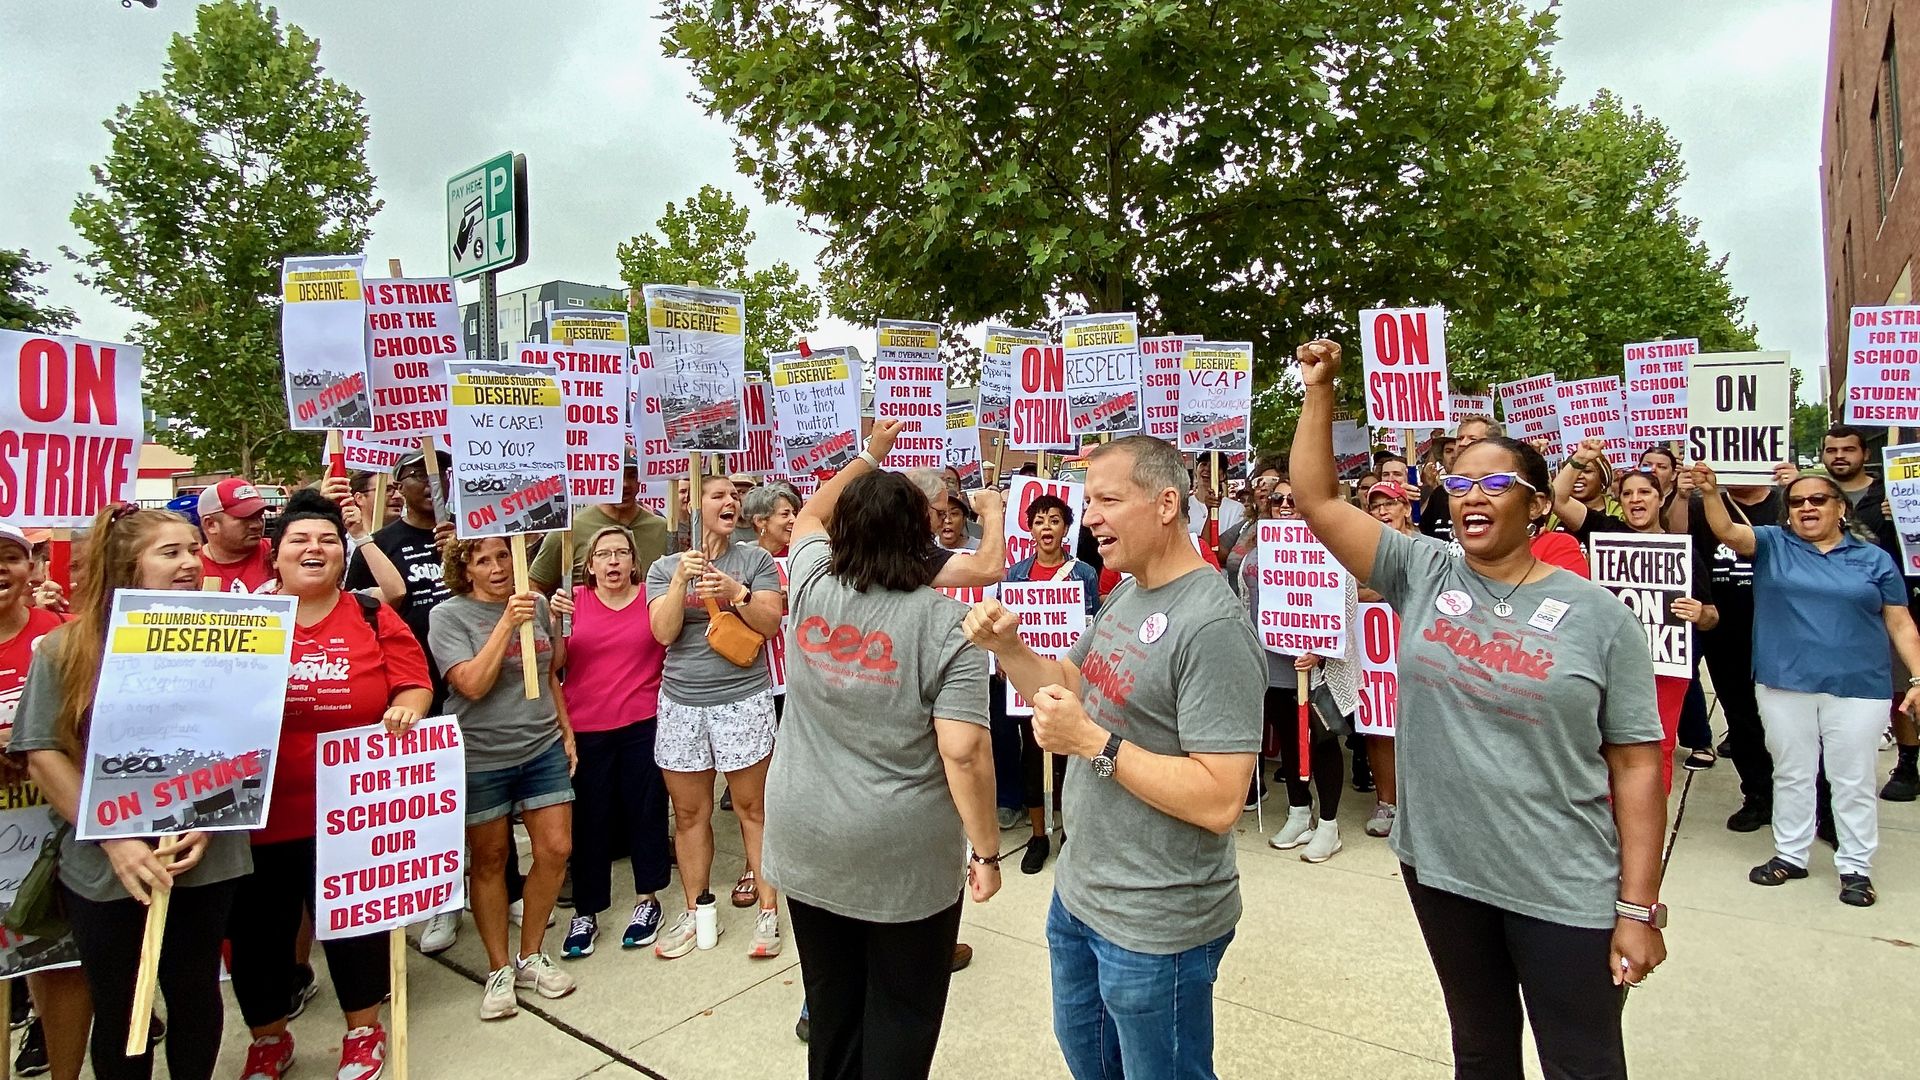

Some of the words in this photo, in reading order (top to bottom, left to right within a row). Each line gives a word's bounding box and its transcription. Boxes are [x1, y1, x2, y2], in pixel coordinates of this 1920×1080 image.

[452, 187, 464, 200] PAY
[466, 178, 483, 195] HERE
[490, 167, 507, 212] P
[325, 270, 350, 281] STUDENTS
[299, 281, 349, 302] DESERVE:
[364, 285, 375, 305] N
[380, 284, 453, 305] STRIKE
[370, 313, 403, 330] FOR
[406, 312, 436, 328] THE
[591, 320, 617, 328] STUDENTS
[666, 311, 725, 333] DESERVE:
[1074, 325, 1100, 333] COLUMBUS
[1101, 323, 1125, 331] STUDENTS
[1853, 312, 1877, 327] ON
[566, 328, 614, 341] DESERVE:
[655, 331, 708, 355] Talisa
[1077, 332, 1122, 346] DESERVE:
[1374, 313, 1429, 366] ON
[1869, 332, 1896, 344] FOR
[374, 335, 457, 357] CHOOLS
[1143, 342, 1160, 354] ON
[1162, 340, 1182, 353] STR
[1627, 348, 1644, 361] ON
[1647, 343, 1695, 359] STRIKE
[394, 362, 429, 379] OUR
[553, 352, 621, 375] STRIKE
[783, 361, 811, 370] COLUMBUS
[811, 358, 837, 368] STUDENTS
[1022, 347, 1063, 393] ON
[1067, 353, 1137, 385] RESPECT
[1155, 358, 1174, 369] FOR
[1195, 358, 1238, 370] DESERVE:
[1640, 364, 1661, 374] FOR
[1663, 361, 1683, 373] THE
[19, 339, 117, 426] ON
[294, 374, 321, 387] cea
[468, 375, 509, 386] COLUMBUS
[511, 376, 546, 387] STUDENTS
[787, 366, 837, 385] DESERVE:
[879, 366, 896, 380] ON
[899, 366, 943, 381] STRIKE
[1147, 374, 1179, 386] SCHO
[1189, 370, 1246, 389] VCAP
[1880, 369, 1910, 381] OUR
[298, 398, 318, 421] ON
[319, 372, 365, 411] STRIKE
[373, 384, 448, 407] TUDENT
[474, 387, 544, 405] DESERVE:
[575, 380, 603, 397] THE
[795, 388, 807, 401] be
[811, 382, 845, 400] treated
[890, 386, 911, 397] FOR
[913, 386, 932, 398] THE
[1166, 390, 1179, 400] OU
[1208, 387, 1227, 396] NOT
[1370, 371, 1445, 422] STRIKE
[1501, 384, 1515, 398] ON
[1516, 377, 1553, 396] STRIKE
[1557, 386, 1574, 398] ON
[1576, 380, 1618, 395] STRIKE
[1716, 375, 1757, 412] ON
[1850, 387, 1920, 400] STUDENT
[794, 403, 809, 415] like
[813, 400, 835, 413] they
[1072, 396, 1097, 406] cea
[1454, 400, 1470, 409] FOR
[1471, 401, 1484, 410] THE
[1513, 398, 1528, 408] FOR
[1529, 394, 1545, 405] THE
[1570, 400, 1589, 410] FOR
[1590, 397, 1608, 408] THE
[1652, 393, 1675, 404] OUR
[880, 403, 942, 417] SCHOOLS
[982, 411, 995, 423] ON
[1074, 414, 1090, 429] ON
[1094, 392, 1135, 420] STRIKE
[1184, 415, 1208, 423] cea
[1507, 404, 1556, 424] SCHOOLS
[1563, 409, 1619, 427] SCHOOLS
[1631, 407, 1688, 421] STUDENT
[374, 409, 448, 432] DESERV
[471, 413, 494, 428] WE
[500, 415, 543, 430] CARE!
[797, 413, 840, 431] matter!
[1525, 421, 1543, 432] OUR
[1184, 431, 1200, 445] ON
[1203, 415, 1245, 439] STRIKE
[1584, 426, 1604, 437] OUR
[468, 440, 492, 456] DO
[498, 440, 535, 458] YOU?
[787, 437, 813, 447] cea
[791, 455, 809, 472] ON
[810, 429, 855, 463] STRIKE
[1689, 426, 1784, 462] STRIKE
[345, 447, 400, 468] ESERV
[0, 430, 133, 517] STRIKE
[459, 463, 516, 472] COUNSELORS
[531, 462, 566, 470] STUDENTS
[465, 479, 507, 493] cea
[468, 505, 497, 530] ON
[501, 475, 563, 516] STRIKE
[1261, 526, 1282, 543] ON
[1274, 550, 1298, 564] FOR
[1301, 550, 1325, 565] THE
[1596, 549, 1686, 585] TEACHERS
[1263, 569, 1339, 588] SCHOOLS
[1005, 589, 1025, 605] ON
[1027, 587, 1081, 605] STRIKE
[1287, 592, 1312, 607] OUR
[1441, 593, 1461, 613] cea
[143, 613, 206, 626] COLUMBUS
[209, 614, 268, 627] STUDENTS
[1020, 612, 1041, 625] FOR
[1044, 611, 1067, 625] THE
[1261, 611, 1341, 630] STUDENTS
[146, 628, 257, 653] DESERVE:
[797, 615, 898, 672] cea
[1020, 631, 1080, 648] CHOOLS
[1266, 632, 1338, 650] DESERVE!
[322, 738, 360, 767] ON
[368, 724, 459, 760] STRIKE
[102, 755, 167, 774] cea
[350, 768, 390, 796] FOR
[397, 762, 436, 787] THE
[97, 791, 142, 827] ON
[153, 751, 262, 808] STRIKE
[326, 789, 457, 835] SCHOOLS
[371, 829, 416, 856] OUR
[323, 849, 459, 900] STUDENTS
[330, 881, 453, 931] DESERVE!
